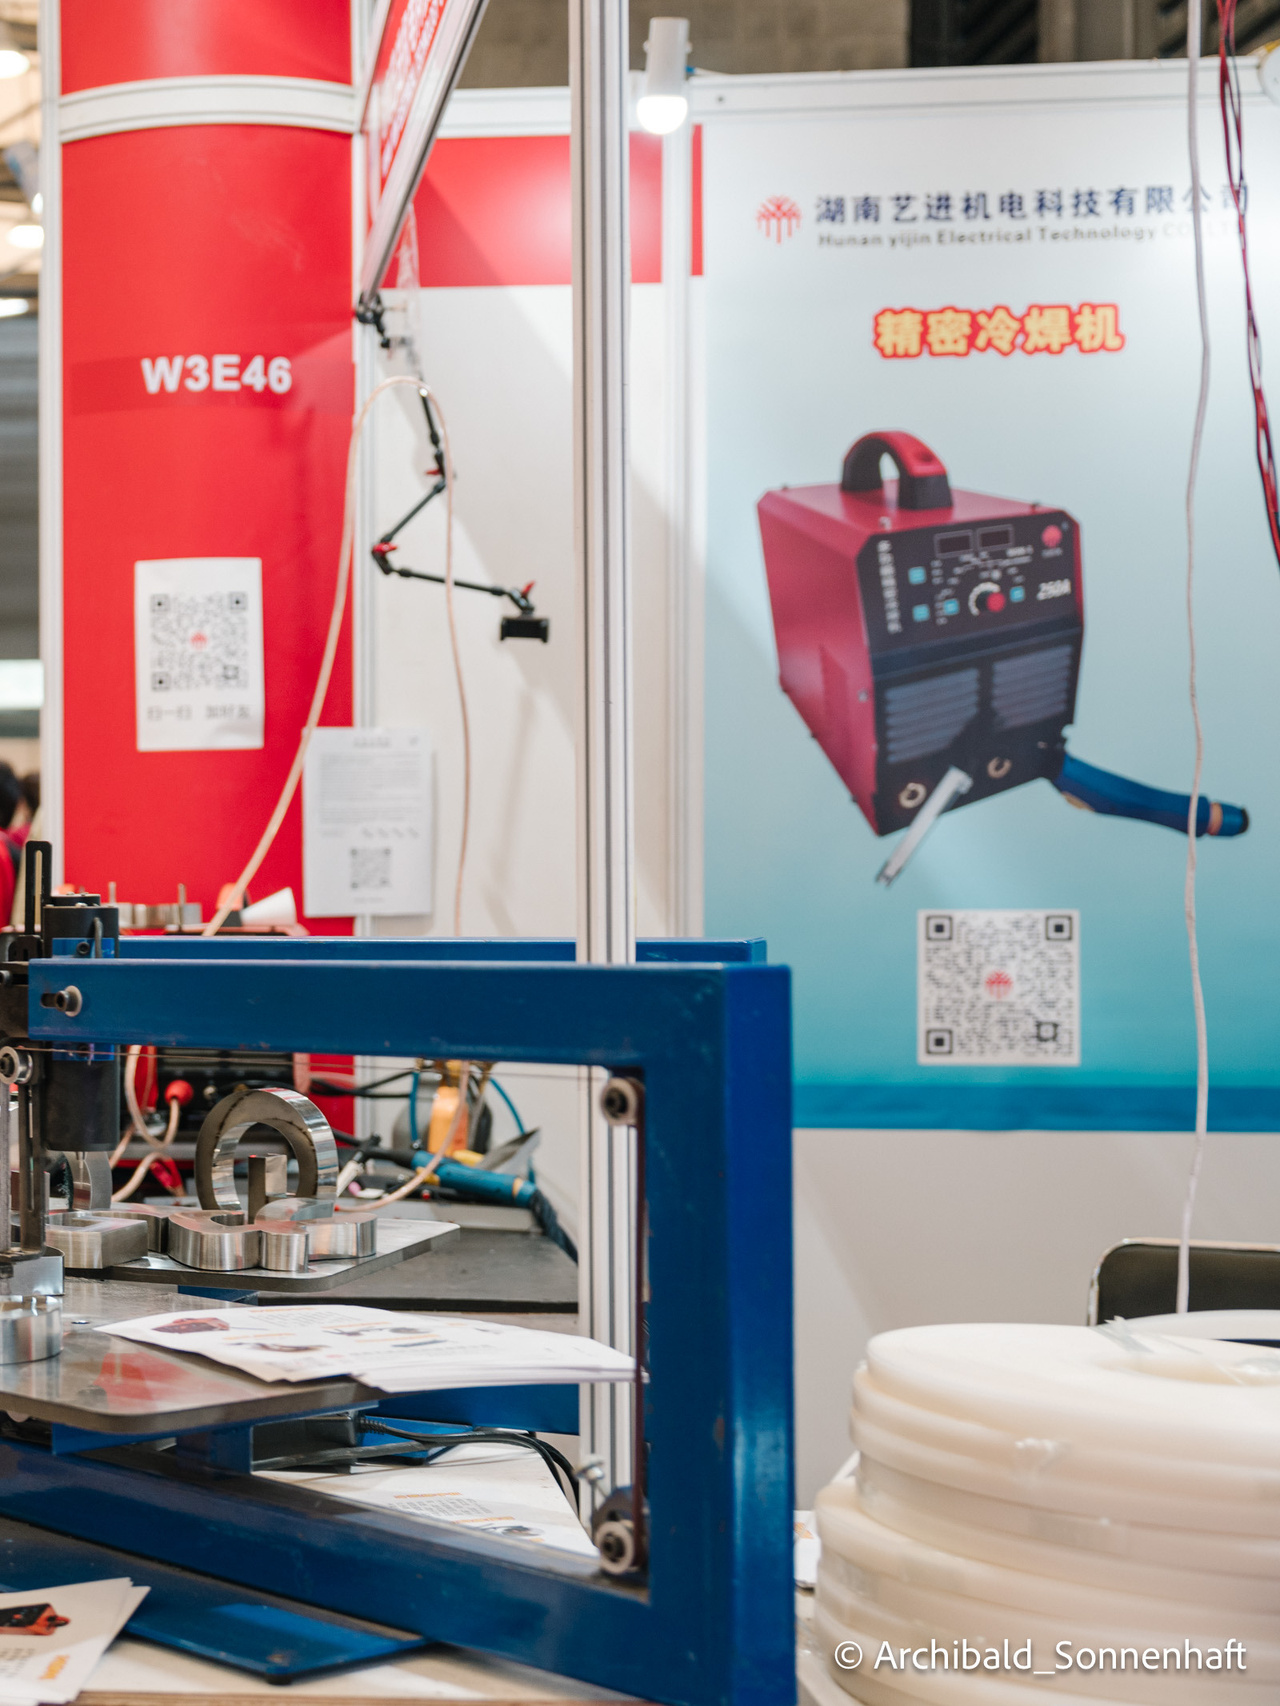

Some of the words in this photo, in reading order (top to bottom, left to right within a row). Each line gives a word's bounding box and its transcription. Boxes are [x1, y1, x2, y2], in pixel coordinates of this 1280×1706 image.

[816, 185, 1248, 223] 湖南艺进机电科技有限公司
[820, 232, 882, 247] Hunan
[888, 231, 932, 249] yijin
[937, 227, 1031, 245] Electrical
[1038, 223, 1156, 242] Technology
[873, 303, 1126, 358] 精密冷焊机
[141, 354, 292, 394] W3E46
